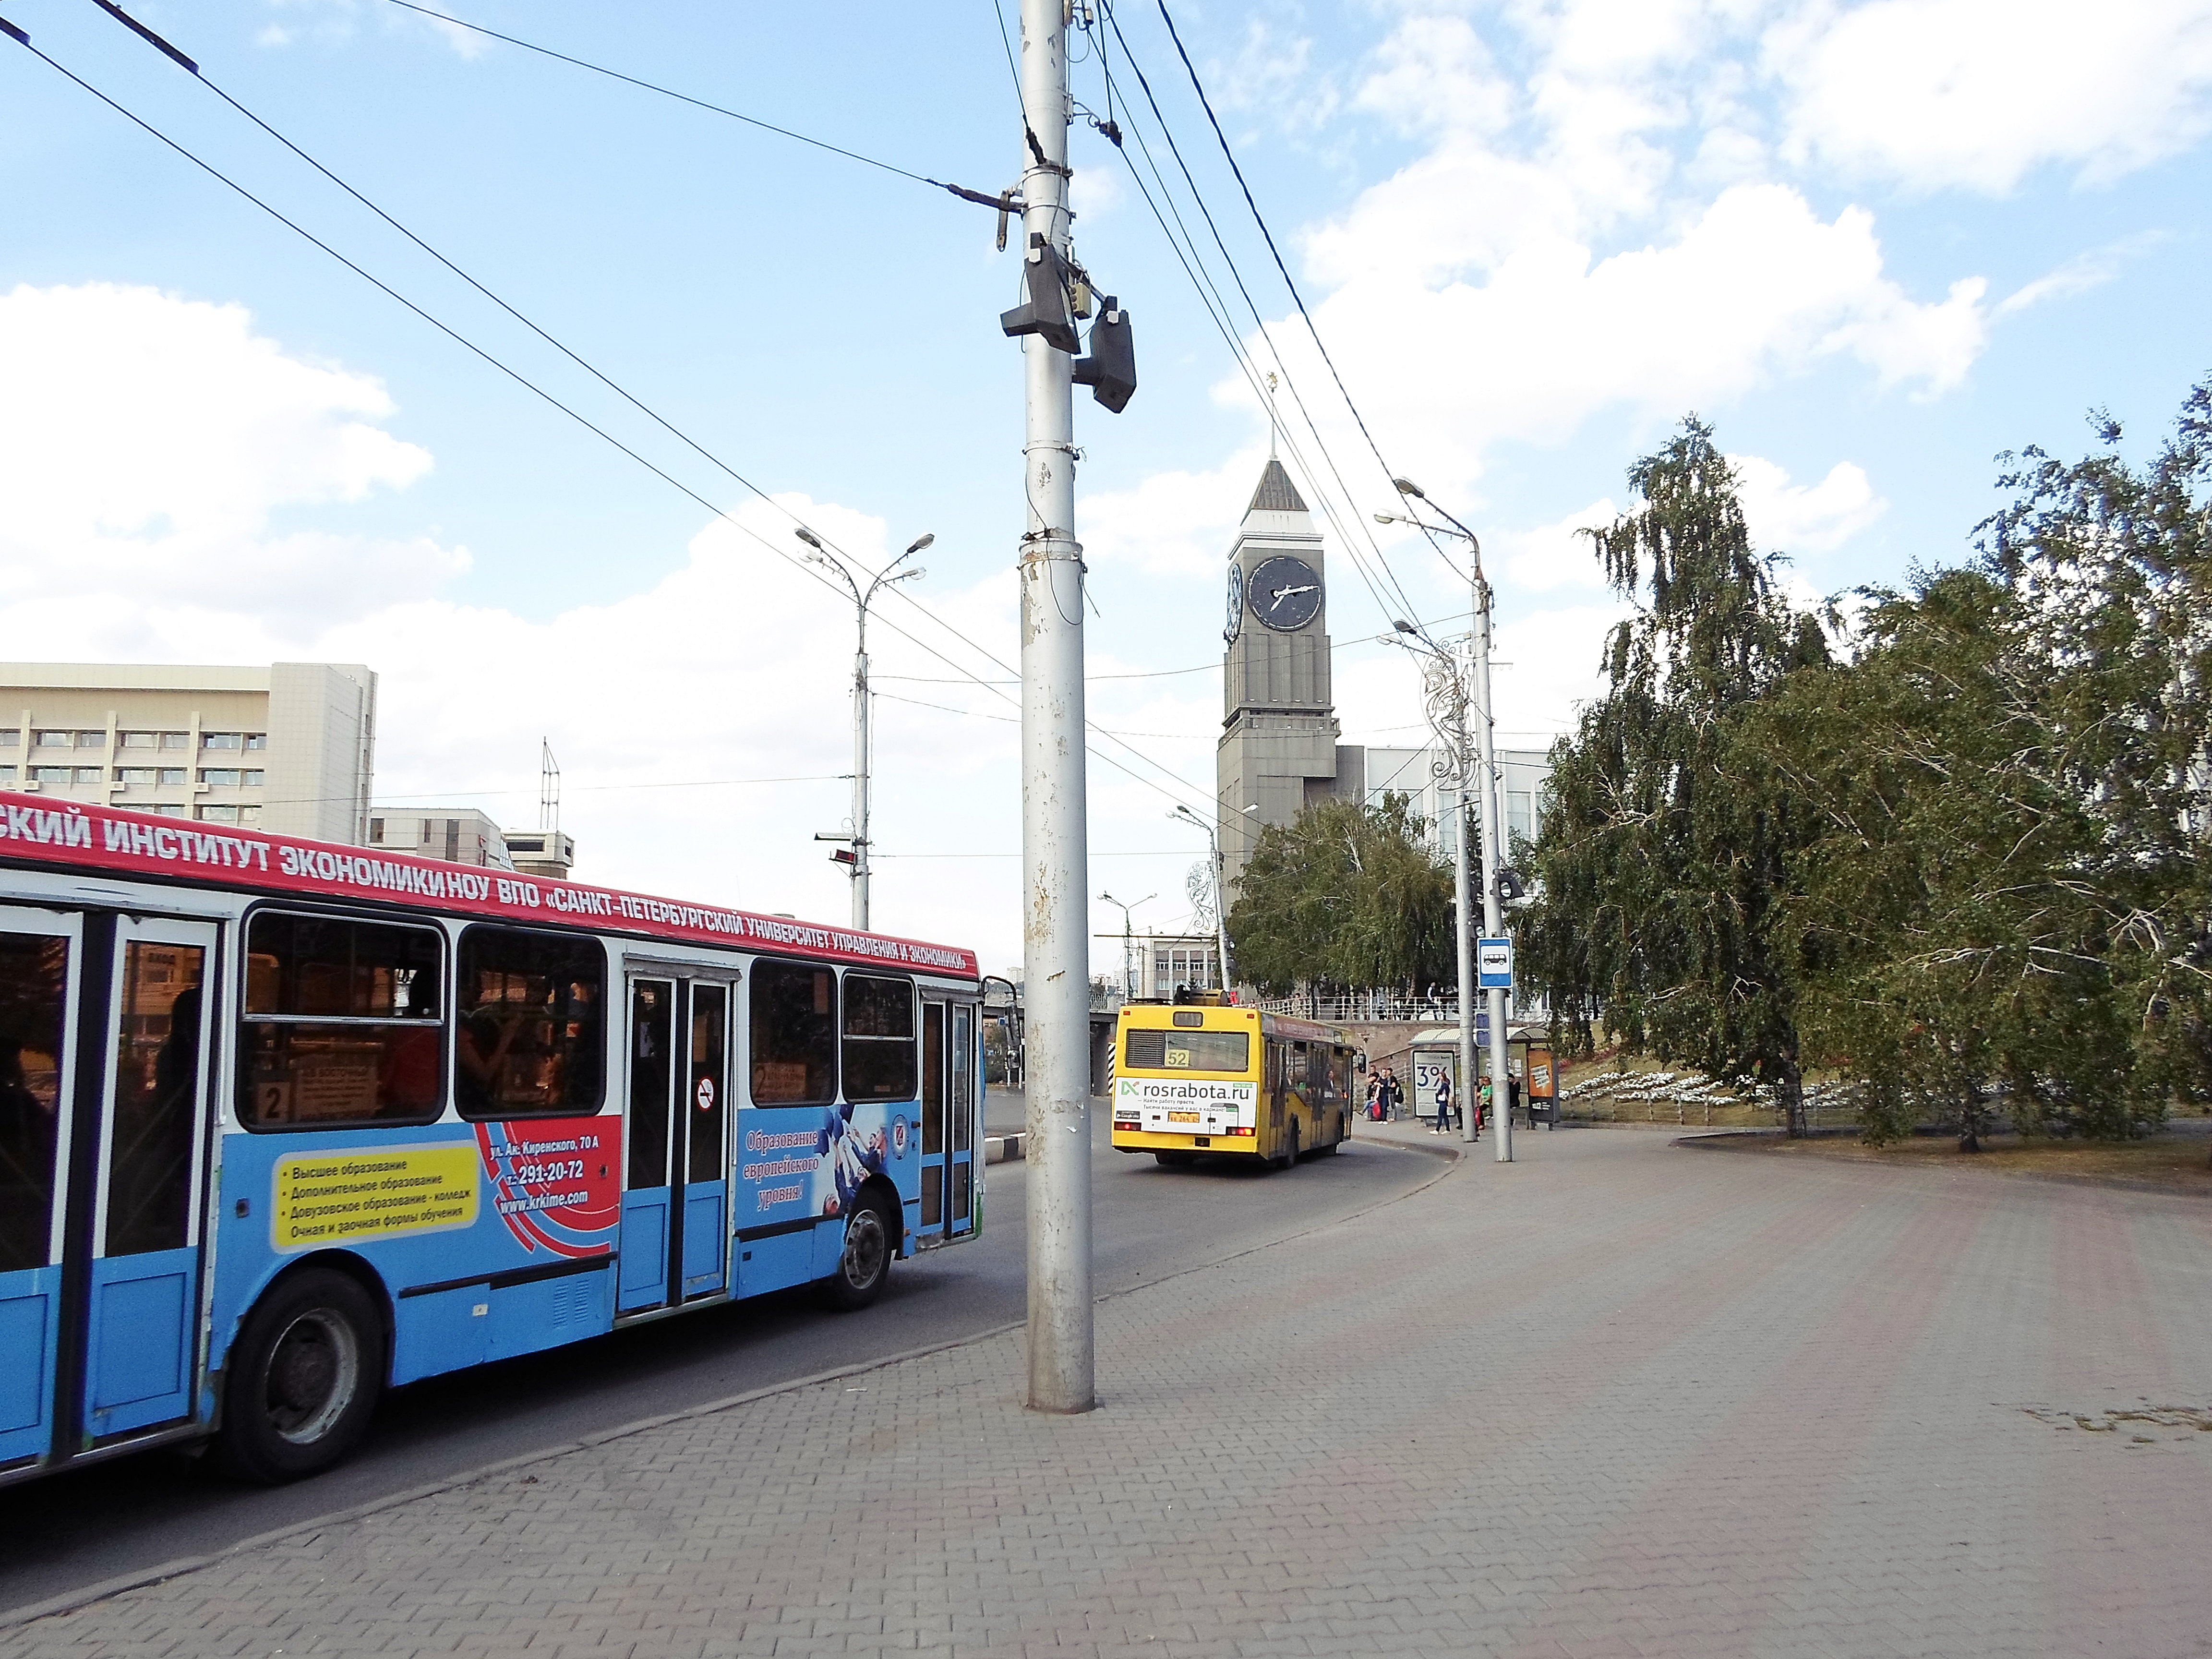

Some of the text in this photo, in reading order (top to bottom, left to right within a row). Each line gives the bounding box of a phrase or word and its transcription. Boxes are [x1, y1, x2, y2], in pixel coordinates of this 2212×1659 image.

[103, 819, 270, 871] ИНСТИТУТ
[496, 878, 540, 907] ВПО
[546, 888, 744, 935] «САНКТ-ПЕТЕРБУРГСКИЙ
[745, 917, 829, 949] УНИВЕРСИТЕТ
[831, 932, 899, 960] УПРАВЛЕНИЯ
[900, 944, 908, 960] И
[909, 946, 966, 969] ЭКОНОМИКИ»
[1168, 1052, 1186, 1065] 52
[755, 1066, 765, 1098] 2
[1143, 1083, 1249, 1099] rosrabota.ru
[265, 1087, 280, 1118] 2
[491, 1146, 504, 1160] ул.
[522, 1139, 577, 1155] Киренского,
[580, 1136, 591, 1149] 70
[592, 1135, 599, 1148] А
[746, 1130, 818, 1156] Образование
[293, 1161, 407, 1179] Высшее образование
[519, 1160, 583, 1184] 291-20-72
[744, 1154, 819, 1184] европейского
[291, 1175, 442, 1200] Дополнительное образование
[757, 1180, 804, 1212] уровня!
[290, 1202, 360, 1219] Довузовское
[363, 1193, 426, 1211] образование
[434, 1189, 471, 1202] колледж
[500, 1190, 588, 1214] www.krkime.com
[291, 1206, 463, 1238] Очная и заочная формы обучения
